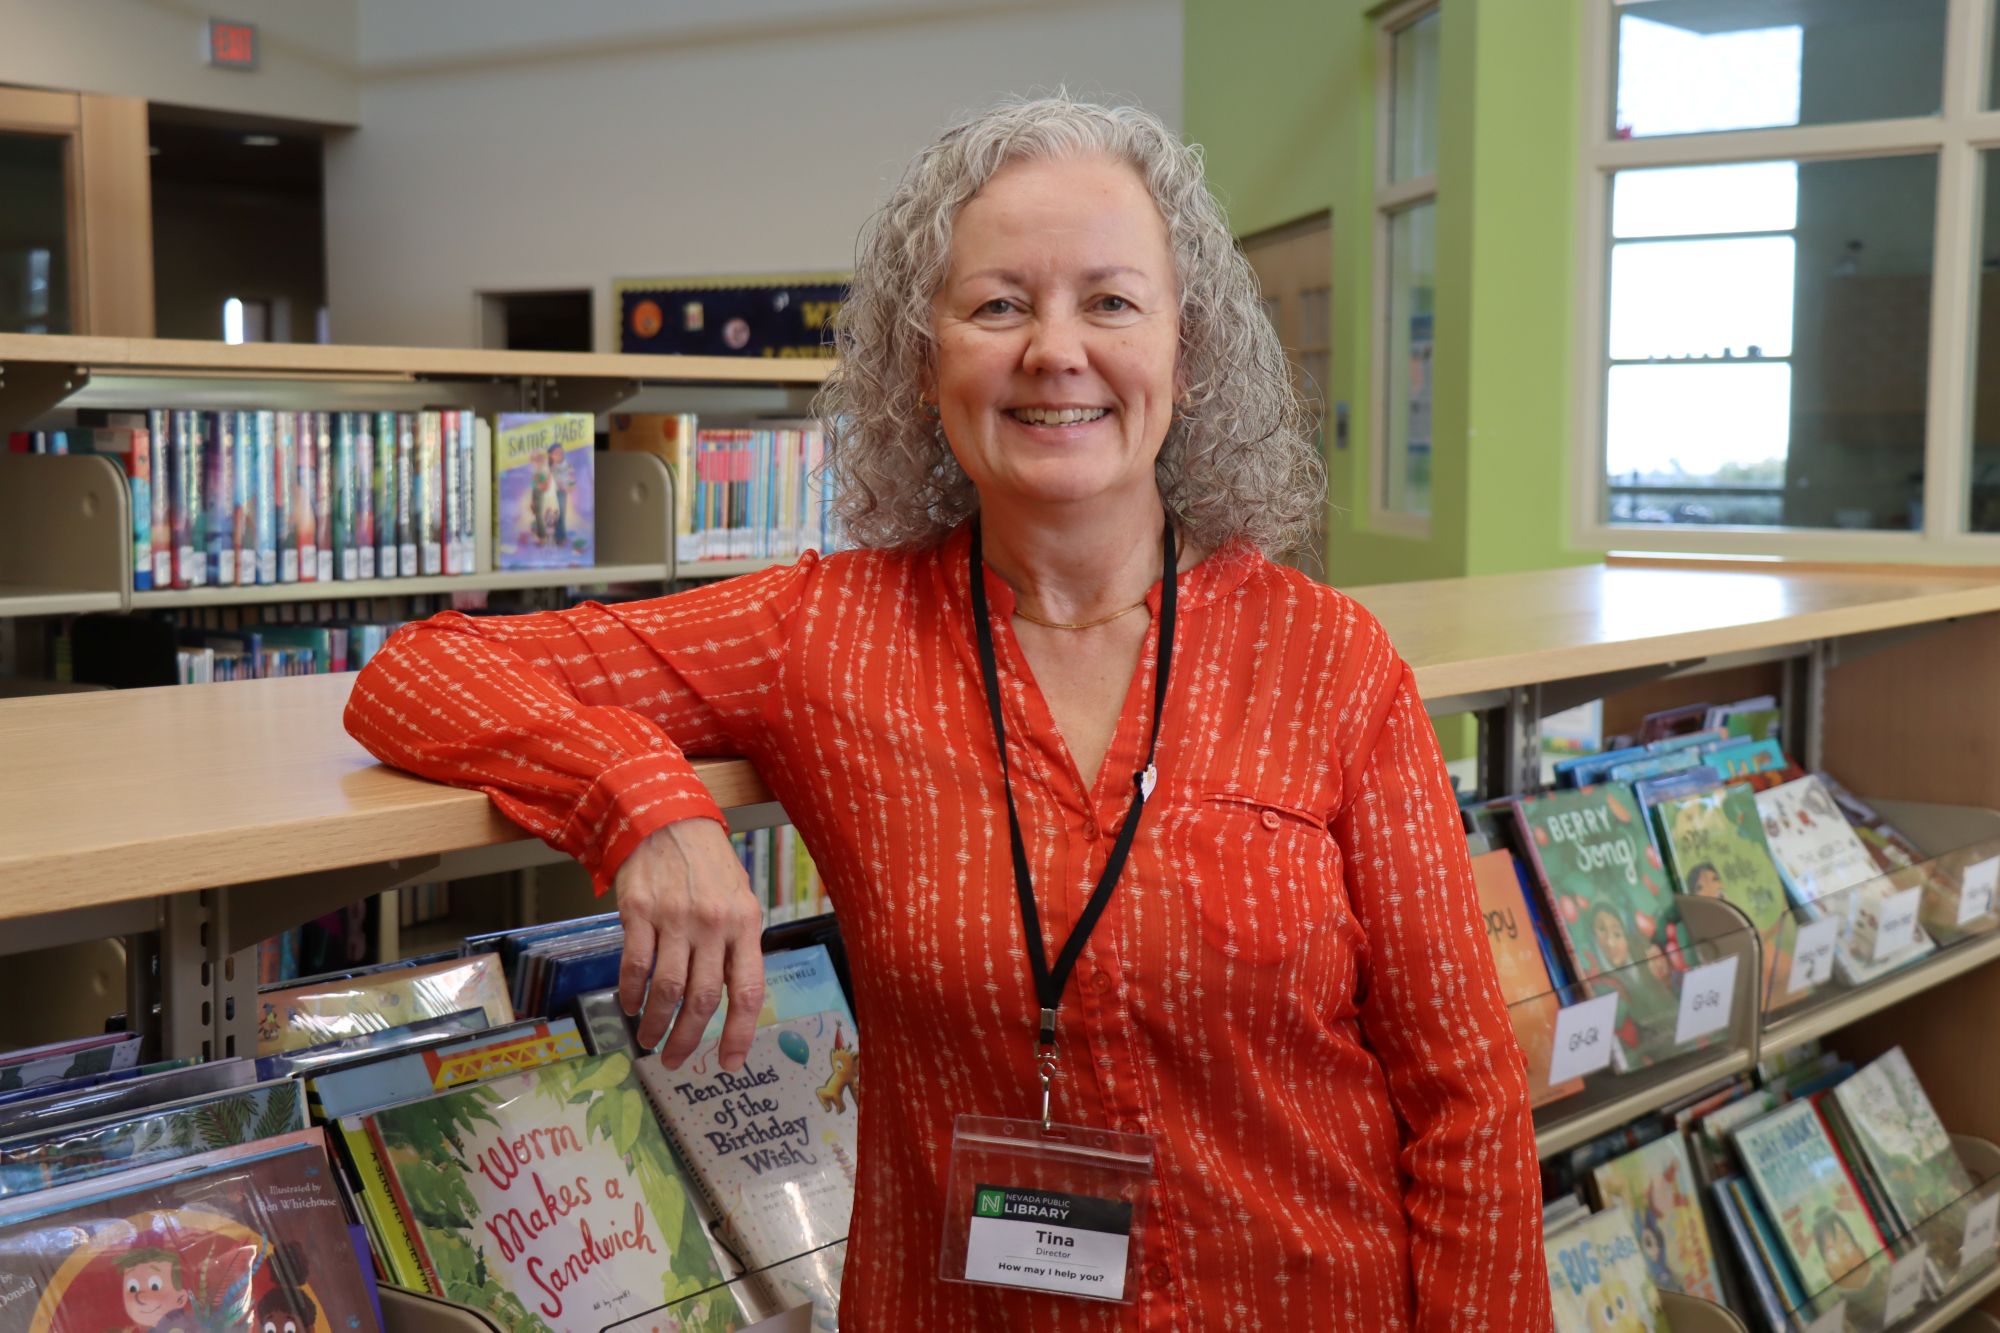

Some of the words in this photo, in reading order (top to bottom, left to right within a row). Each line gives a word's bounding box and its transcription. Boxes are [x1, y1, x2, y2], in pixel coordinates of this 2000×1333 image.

[213, 24, 252, 63] EXIT
[553, 417, 586, 443] PAGE
[1547, 805, 1611, 843] BERRY
[1576, 836, 1638, 886] Song
[674, 1083, 725, 1105] Ten
[714, 1061, 780, 1095] Rules
[714, 1098, 739, 1129] of
[737, 1092, 779, 1118] the
[704, 1116, 809, 1156] Birthday
[477, 1125, 583, 1191] Worm
[740, 1140, 817, 1177] Wish
[259, 1200, 279, 1213] Ben
[281, 1197, 337, 1210] Whitehouse
[269, 1183, 311, 1195] Illustrated
[312, 1182, 322, 1194] by
[1006, 1194, 1040, 1205] NEVADA
[1042, 1197, 1071, 1208] PUBLIC
[485, 1171, 592, 1263] Makes
[605, 1177, 625, 1199] a
[1004, 1202, 1070, 1220] LIBRARY
[1036, 1230, 1075, 1247] Tina
[1036, 1247, 1071, 1259] Director
[526, 1201, 657, 1318] Sandwich
[998, 1262, 1021, 1272] How
[1024, 1267, 1046, 1276] may
[1054, 1269, 1077, 1280] help
[1080, 1273, 1104, 1282] you?
